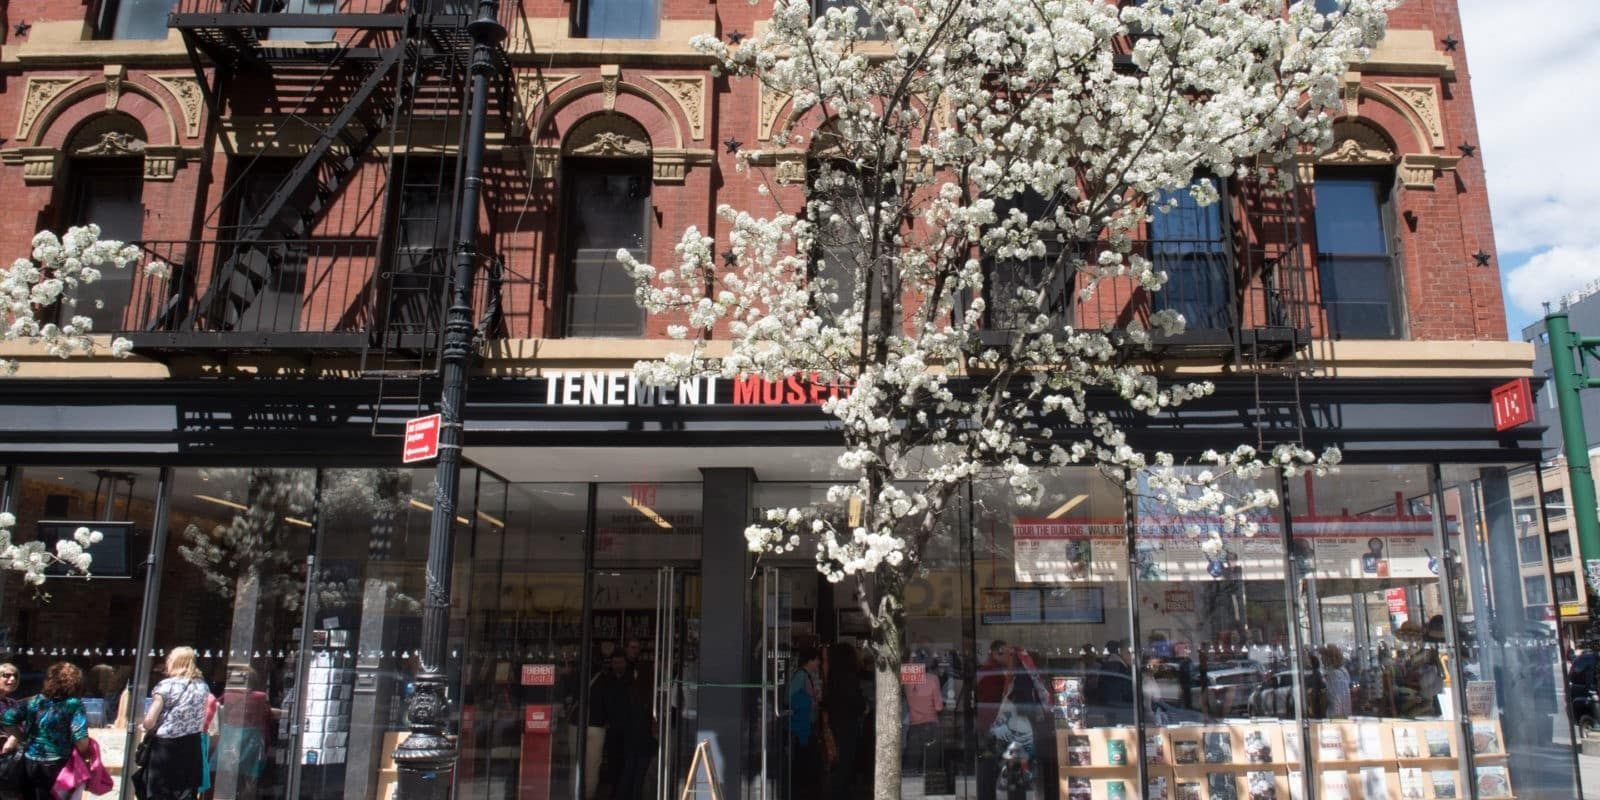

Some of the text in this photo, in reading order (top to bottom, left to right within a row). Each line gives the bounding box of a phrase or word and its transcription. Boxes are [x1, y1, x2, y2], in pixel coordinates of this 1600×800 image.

[543, 371, 851, 405] TENEMENT MUSE
[1113, 525, 1125, 535] TH
